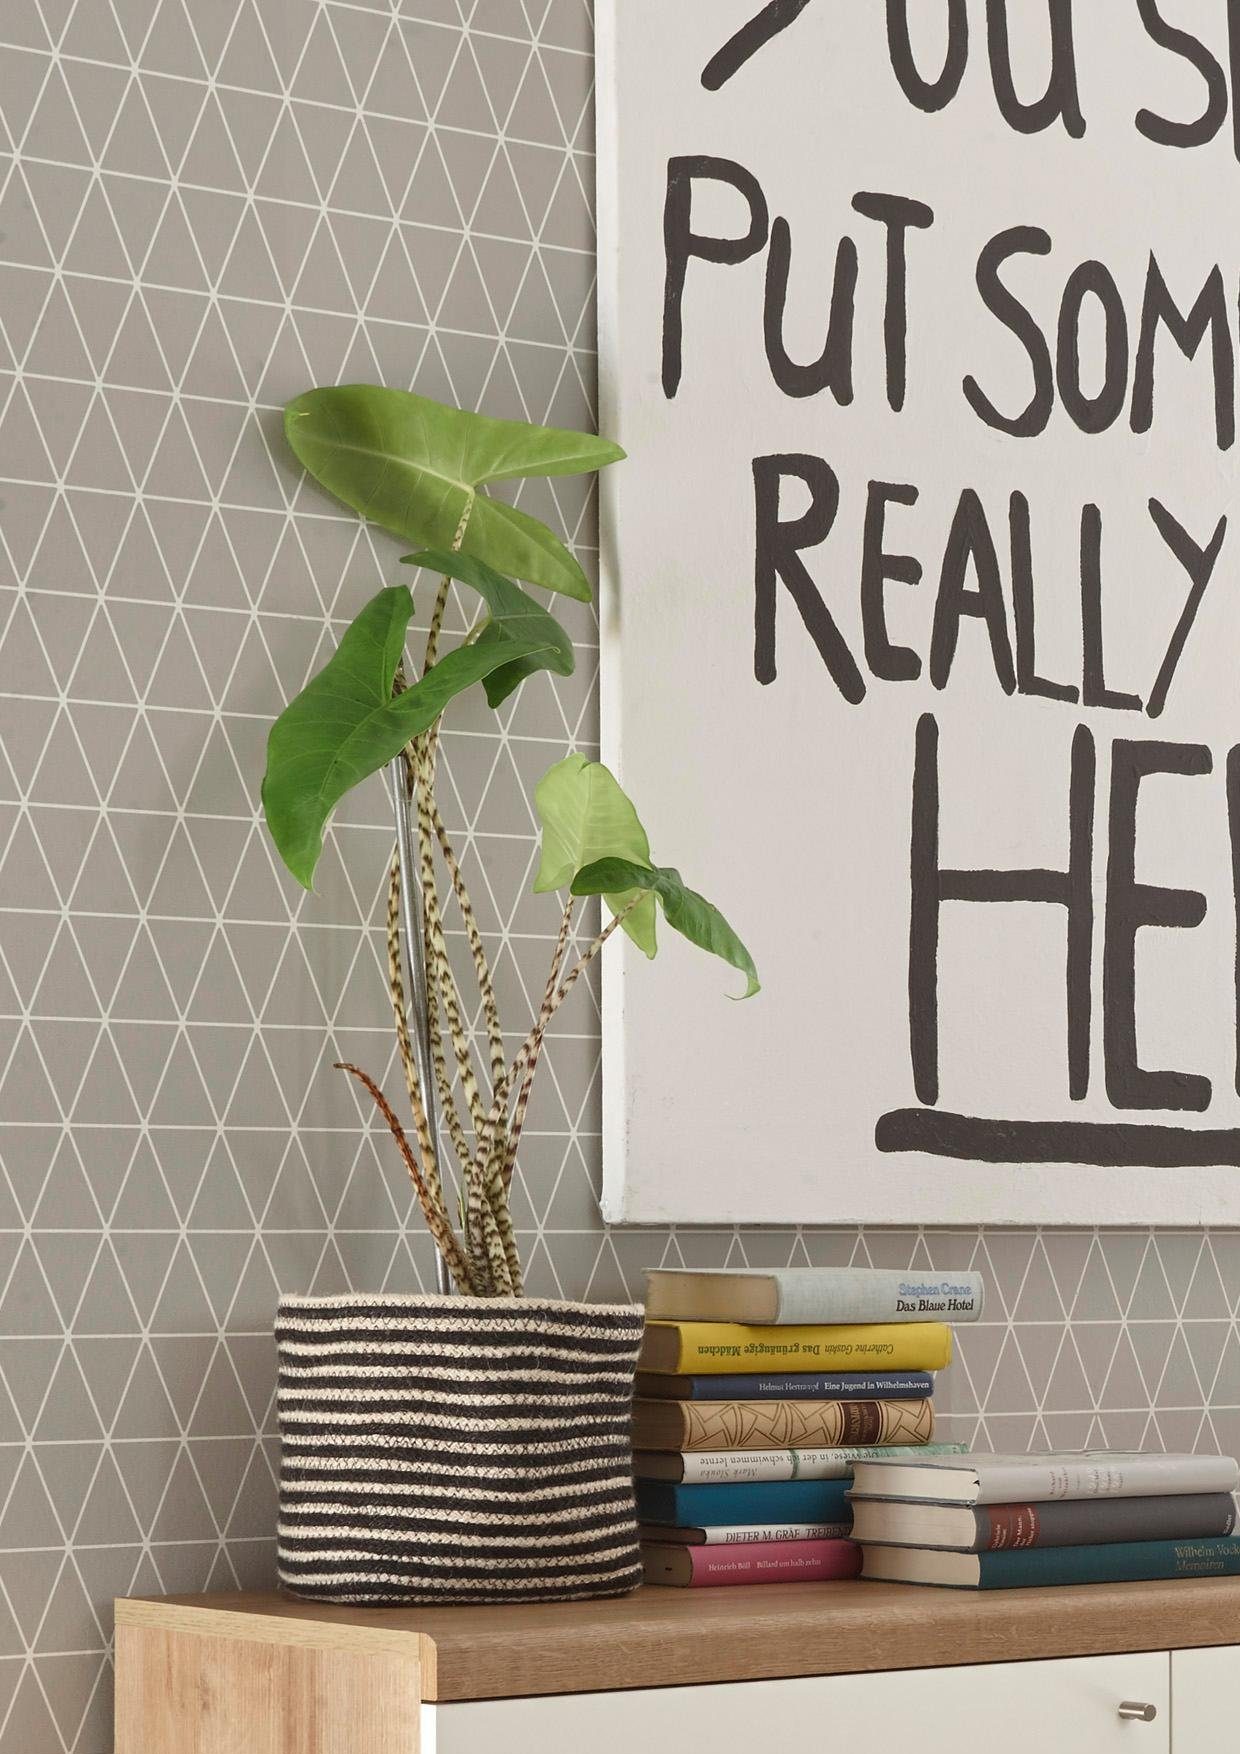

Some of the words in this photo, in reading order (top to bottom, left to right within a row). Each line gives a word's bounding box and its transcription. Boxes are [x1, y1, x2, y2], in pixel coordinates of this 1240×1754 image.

[662, 156, 934, 412] PUT
[752, 454, 1227, 718] REALLY
[898, 1283, 939, 1298] Stephen
[941, 1283, 972, 1295] Crane
[896, 1300, 916, 1312] Das
[918, 1299, 946, 1311] Blaue
[947, 1299, 974, 1311] Hotel
[698, 1346, 741, 1356] Mädchen
[802, 1345, 820, 1355] Das
[855, 1344, 894, 1355] Catherine
[824, 1382, 840, 1390] Eine
[841, 1382, 866, 1391] Jugend
[867, 1381, 875, 1389] in
[876, 1380, 929, 1389] Wilhelmshaven
[700, 1456, 728, 1466] lernte
[726, 1531, 759, 1543] DIETER
[763, 1530, 774, 1541] M.
[708, 1562, 736, 1571] Heinrich
